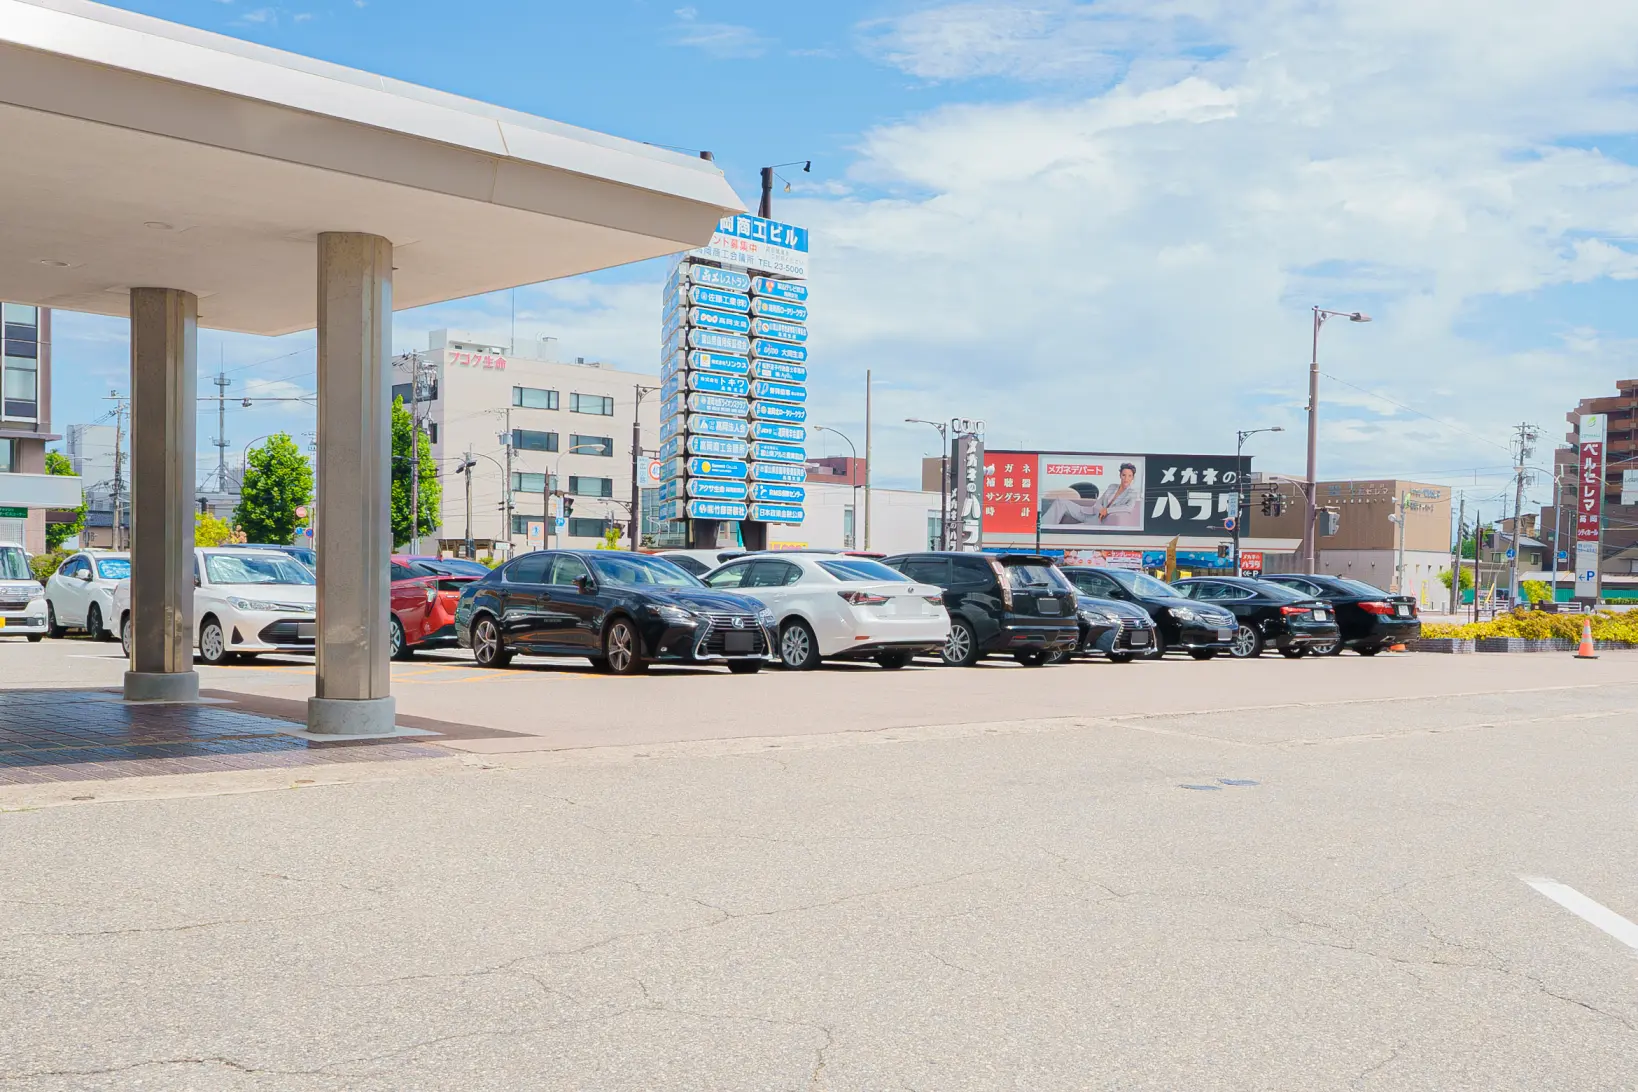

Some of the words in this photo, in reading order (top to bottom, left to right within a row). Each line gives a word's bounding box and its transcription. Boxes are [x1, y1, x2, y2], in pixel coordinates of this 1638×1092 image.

[759, 258, 772, 268] TEL
[774, 262, 804, 275] 23-5000
[1048, 465, 1103, 475] メガネデパート
[1160, 467, 1237, 485] メガネの
[1583, 443, 1599, 511] ベルセレマ
[986, 477, 1031, 488] 補聴器
[986, 492, 1030, 502] サングラス
[986, 507, 1031, 517] 時計
[1586, 570, 1595, 581] P
